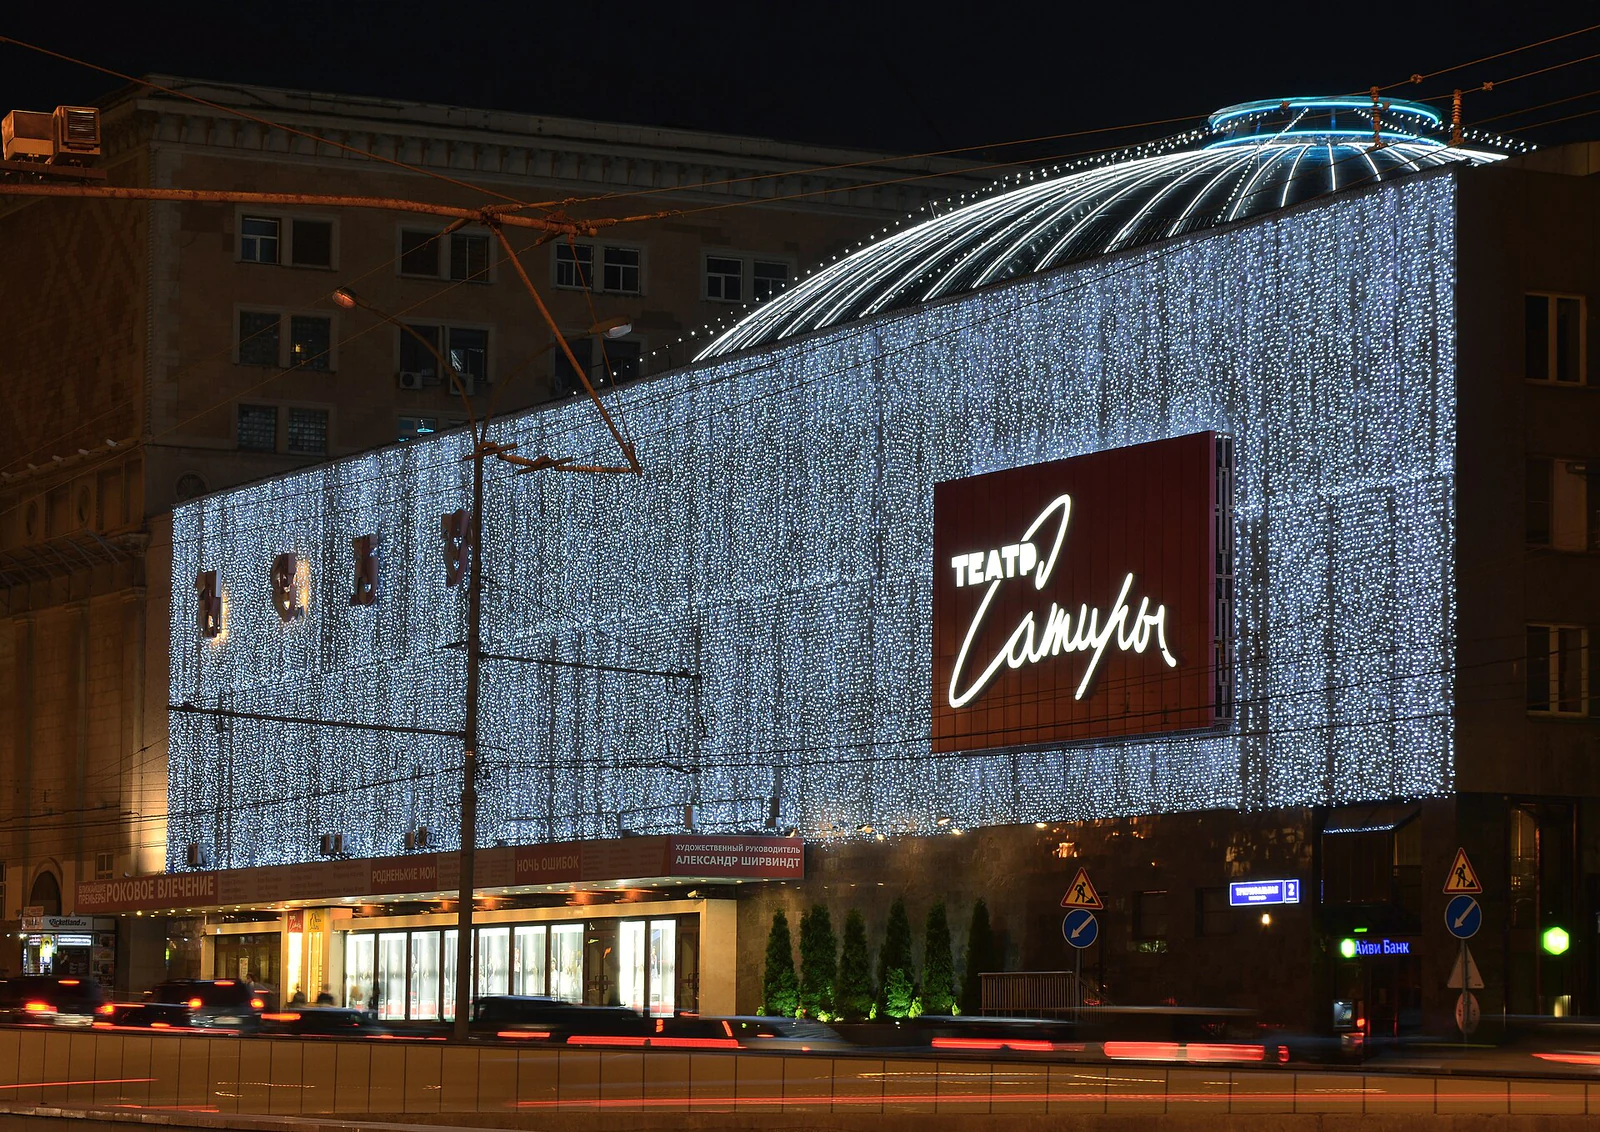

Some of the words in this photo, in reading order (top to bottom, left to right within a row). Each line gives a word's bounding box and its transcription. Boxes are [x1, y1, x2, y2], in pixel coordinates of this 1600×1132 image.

[951, 542, 1037, 588] ТЕАТР
[675, 843, 744, 852] ХУДОЖЕСТВЕННЫЙ
[745, 846, 801, 855] РУКОВОДИТЕЛЬ
[516, 858, 540, 873] НОЧЬ
[541, 855, 580, 871] ОШИБОК
[675, 855, 739, 867] АЛЕКСАНДР
[741, 856, 801, 869] ШИРВИНДТ
[372, 868, 418, 884] РОДНЕНЬКИЕ
[419, 866, 436, 879] МОИ
[106, 880, 155, 903] РОКОВОЕ
[157, 875, 214, 898] ВЛЕЧЕНИЕ
[1288, 883, 1295, 896] 2
[1355, 940, 1381, 955] Айви
[1383, 939, 1409, 954] Банк
